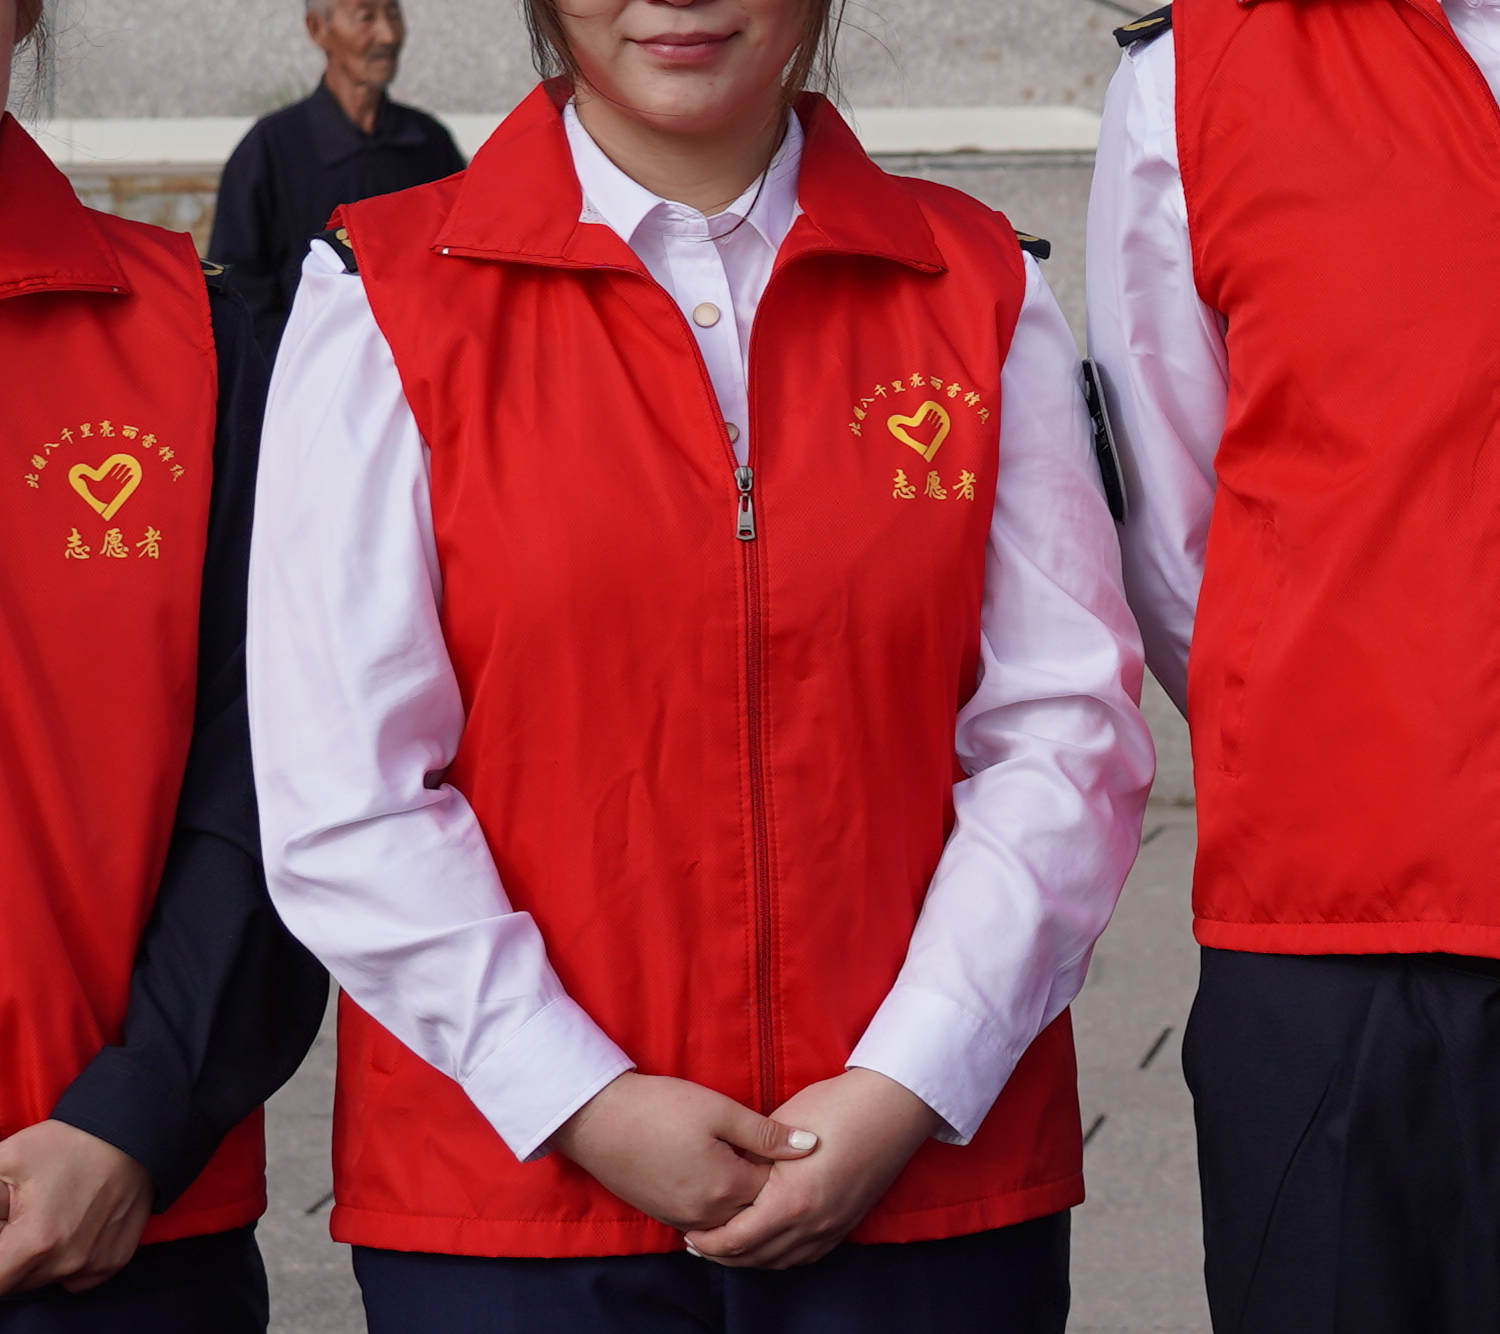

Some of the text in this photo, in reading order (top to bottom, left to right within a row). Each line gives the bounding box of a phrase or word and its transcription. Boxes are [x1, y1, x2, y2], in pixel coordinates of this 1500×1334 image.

[892, 469, 977, 501] 志愿者
[65, 526, 162, 559] 志愿者
